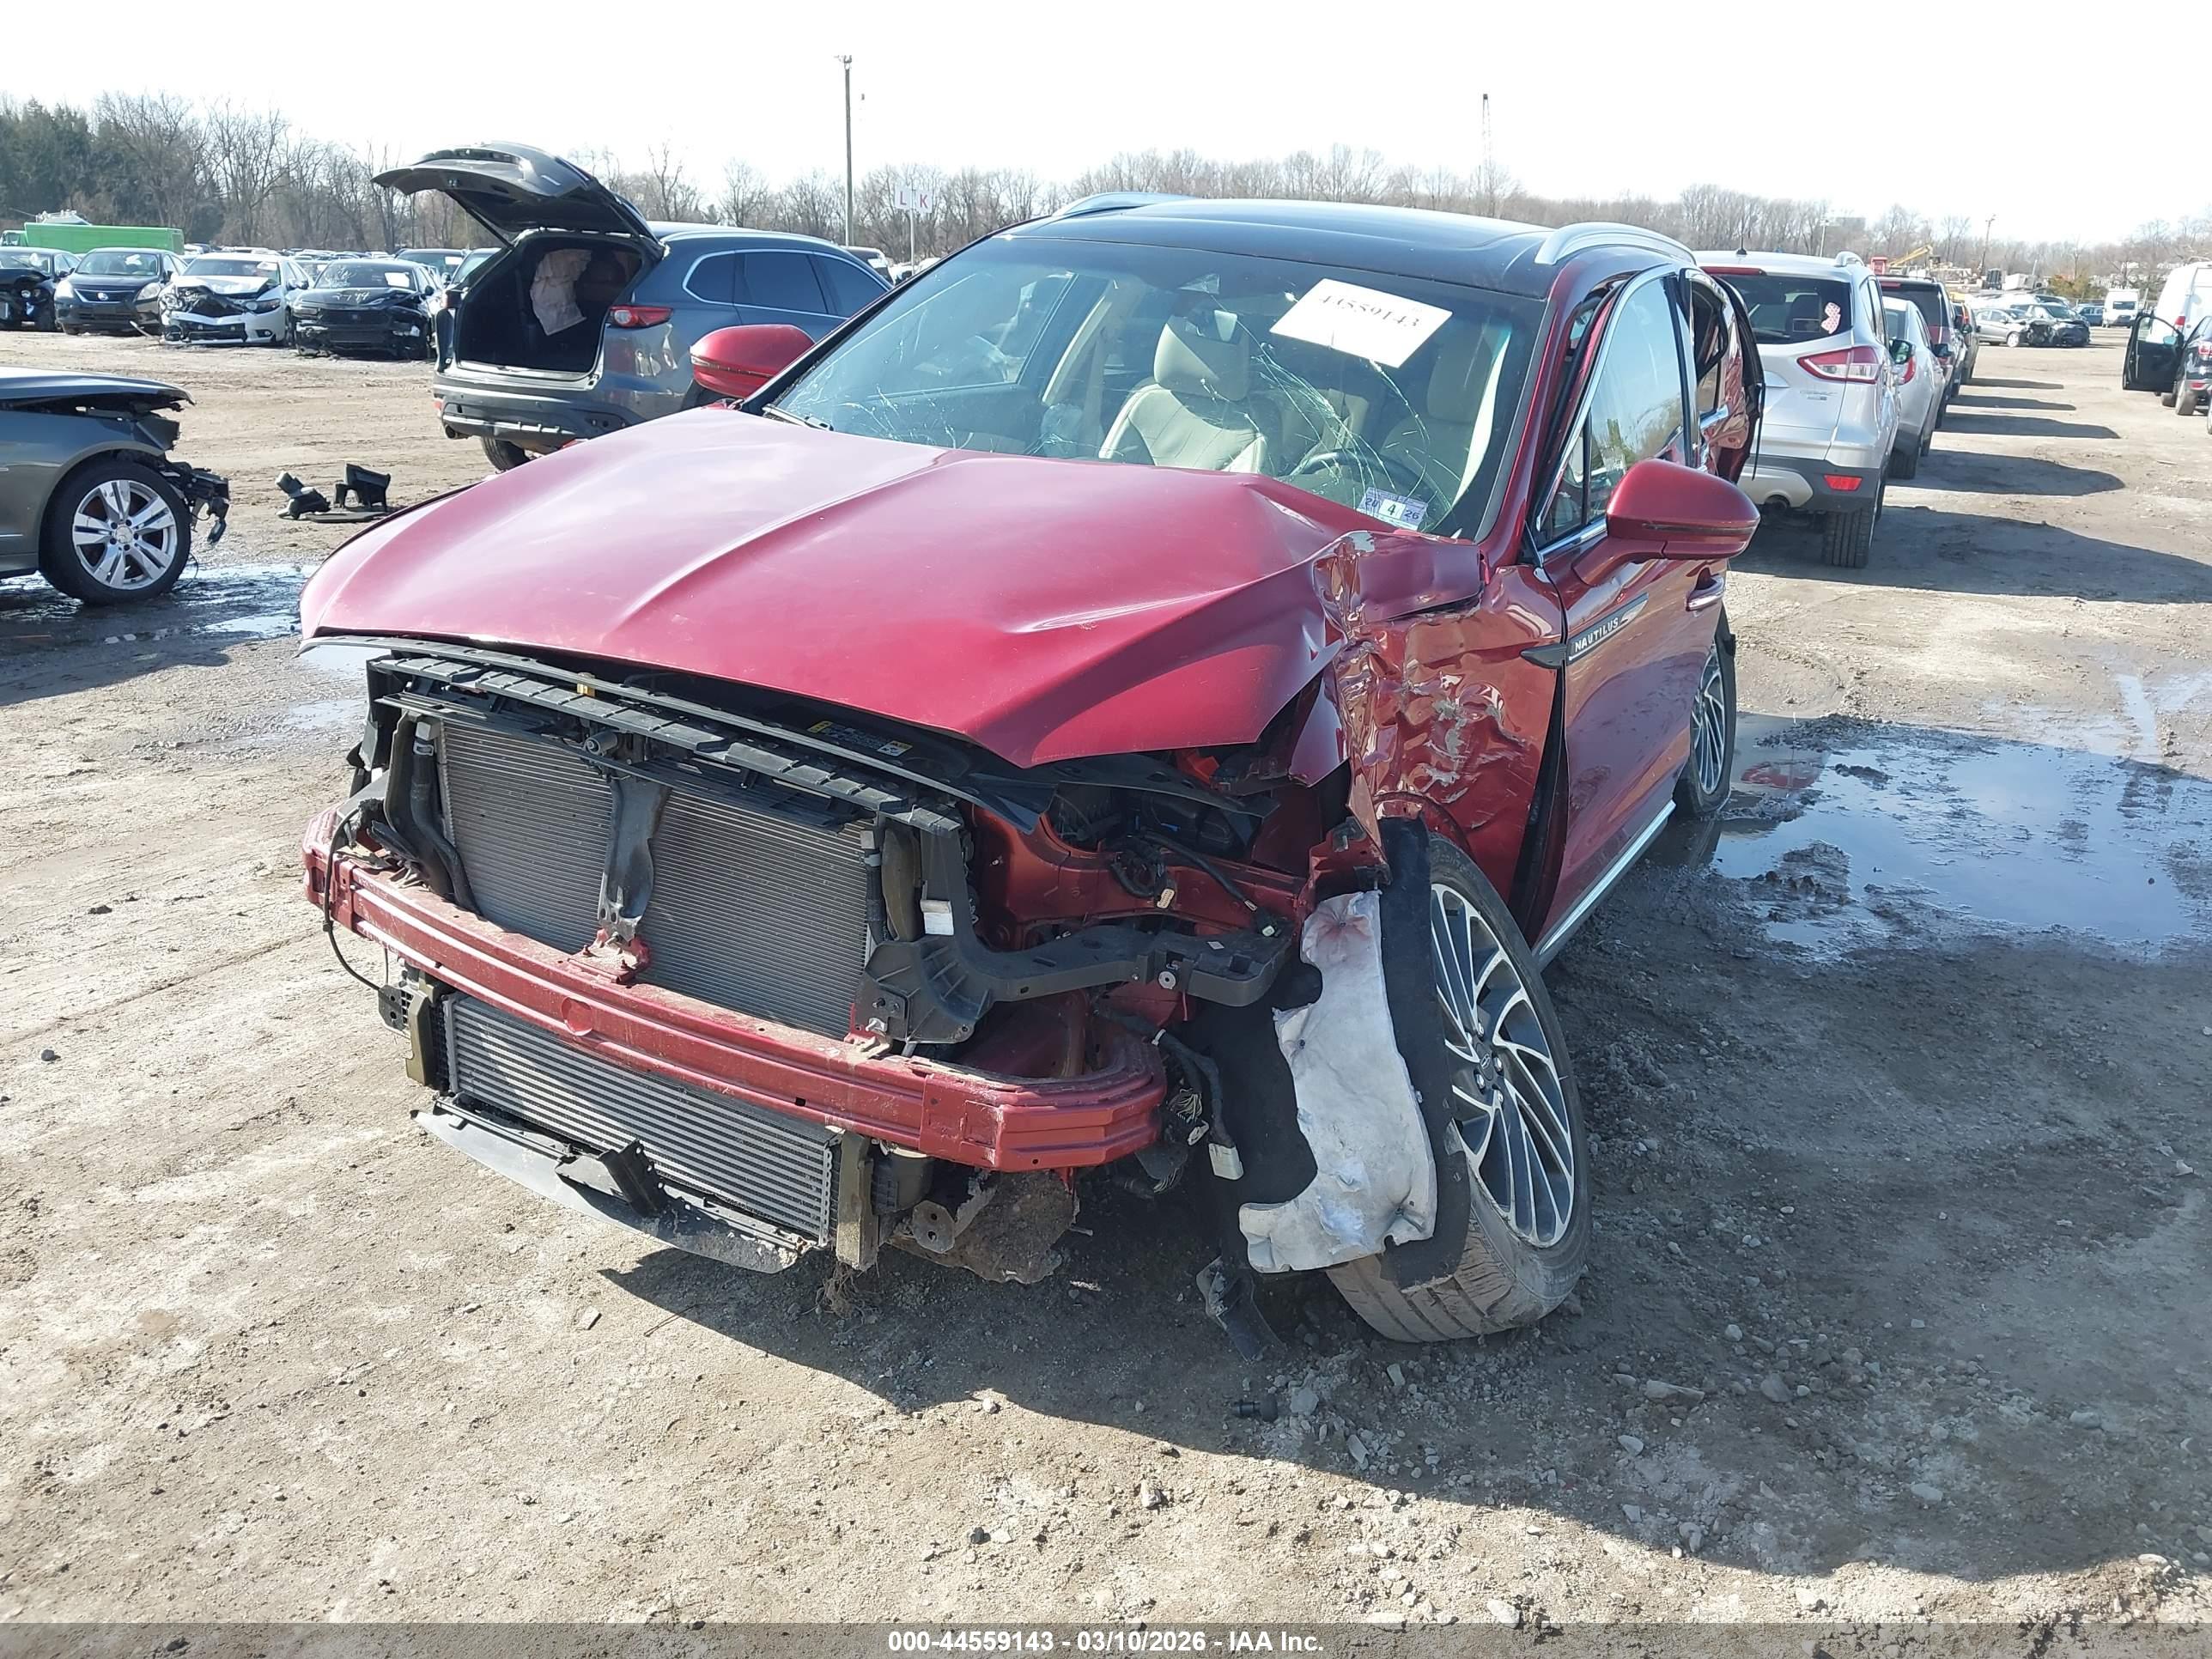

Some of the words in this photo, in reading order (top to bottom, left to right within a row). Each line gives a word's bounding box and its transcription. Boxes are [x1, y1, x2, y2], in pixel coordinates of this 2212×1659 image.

[899, 191, 907, 205] L
[920, 194, 928, 209] K
[1387, 503, 1396, 515] 4
[1404, 510, 1420, 520] 26
[1574, 617, 1620, 653] NAUTILUS
